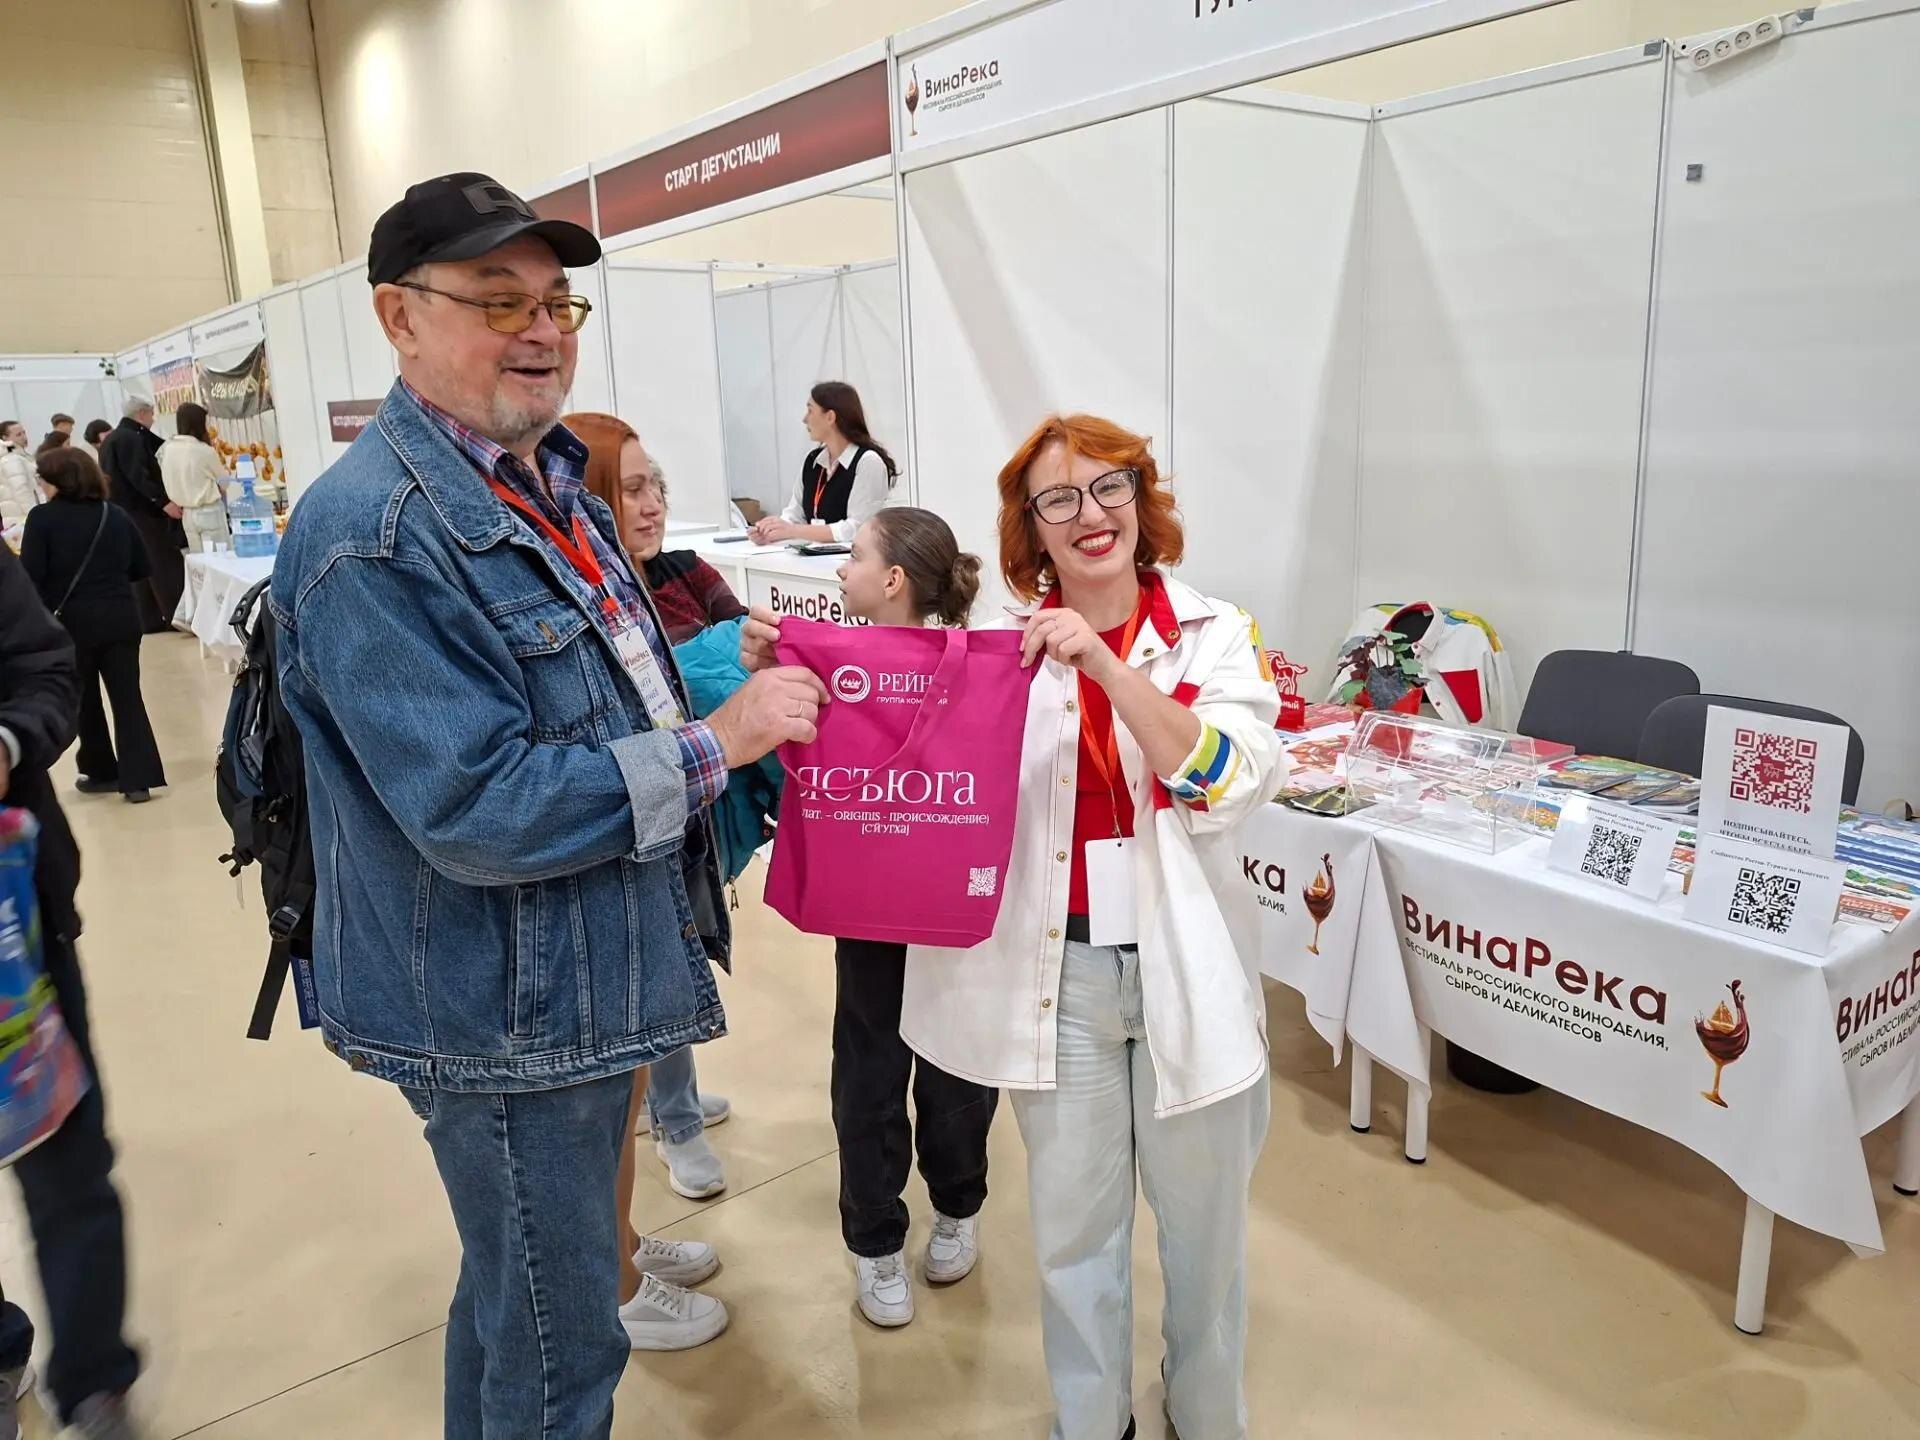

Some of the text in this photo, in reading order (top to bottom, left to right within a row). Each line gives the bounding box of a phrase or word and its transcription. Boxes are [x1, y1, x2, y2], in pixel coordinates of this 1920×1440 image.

[925, 60, 999, 98] ВинаРека
[664, 132, 781, 192] СТАРТ ДЕГУСТАЦИИ
[876, 696, 905, 704] ГРУППА
[1401, 893, 1668, 1026] ВинаРека
[1405, 937, 1670, 1051] ФЕСТИВАЛЬ РОССИЙСКОГО ВИНОДЕЛИЯ,
[1445, 974, 1603, 1043] СЫРОВ И ДЕЛИКАТЕСОВ
[1836, 949, 1920, 1044] ВинаР
[1860, 1043, 1888, 1067] СЫРОВ
